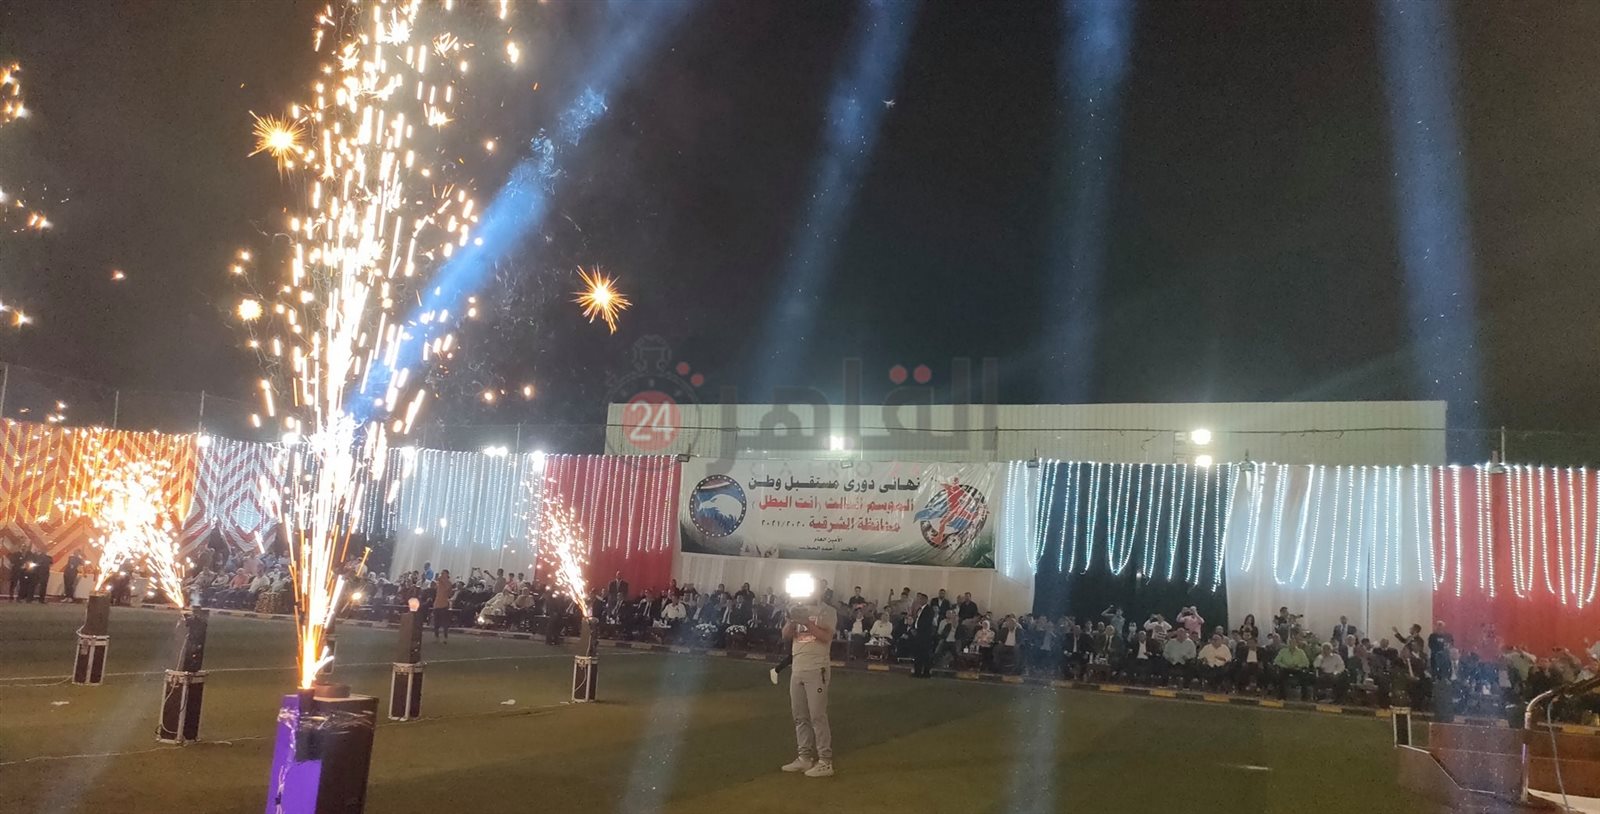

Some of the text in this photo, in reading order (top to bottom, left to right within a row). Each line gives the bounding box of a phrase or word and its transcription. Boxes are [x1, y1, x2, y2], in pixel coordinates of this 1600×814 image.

[748, 475, 782, 491] وطن
[784, 475, 839, 491] مستقبل
[809, 515, 854, 533] الشرقية
